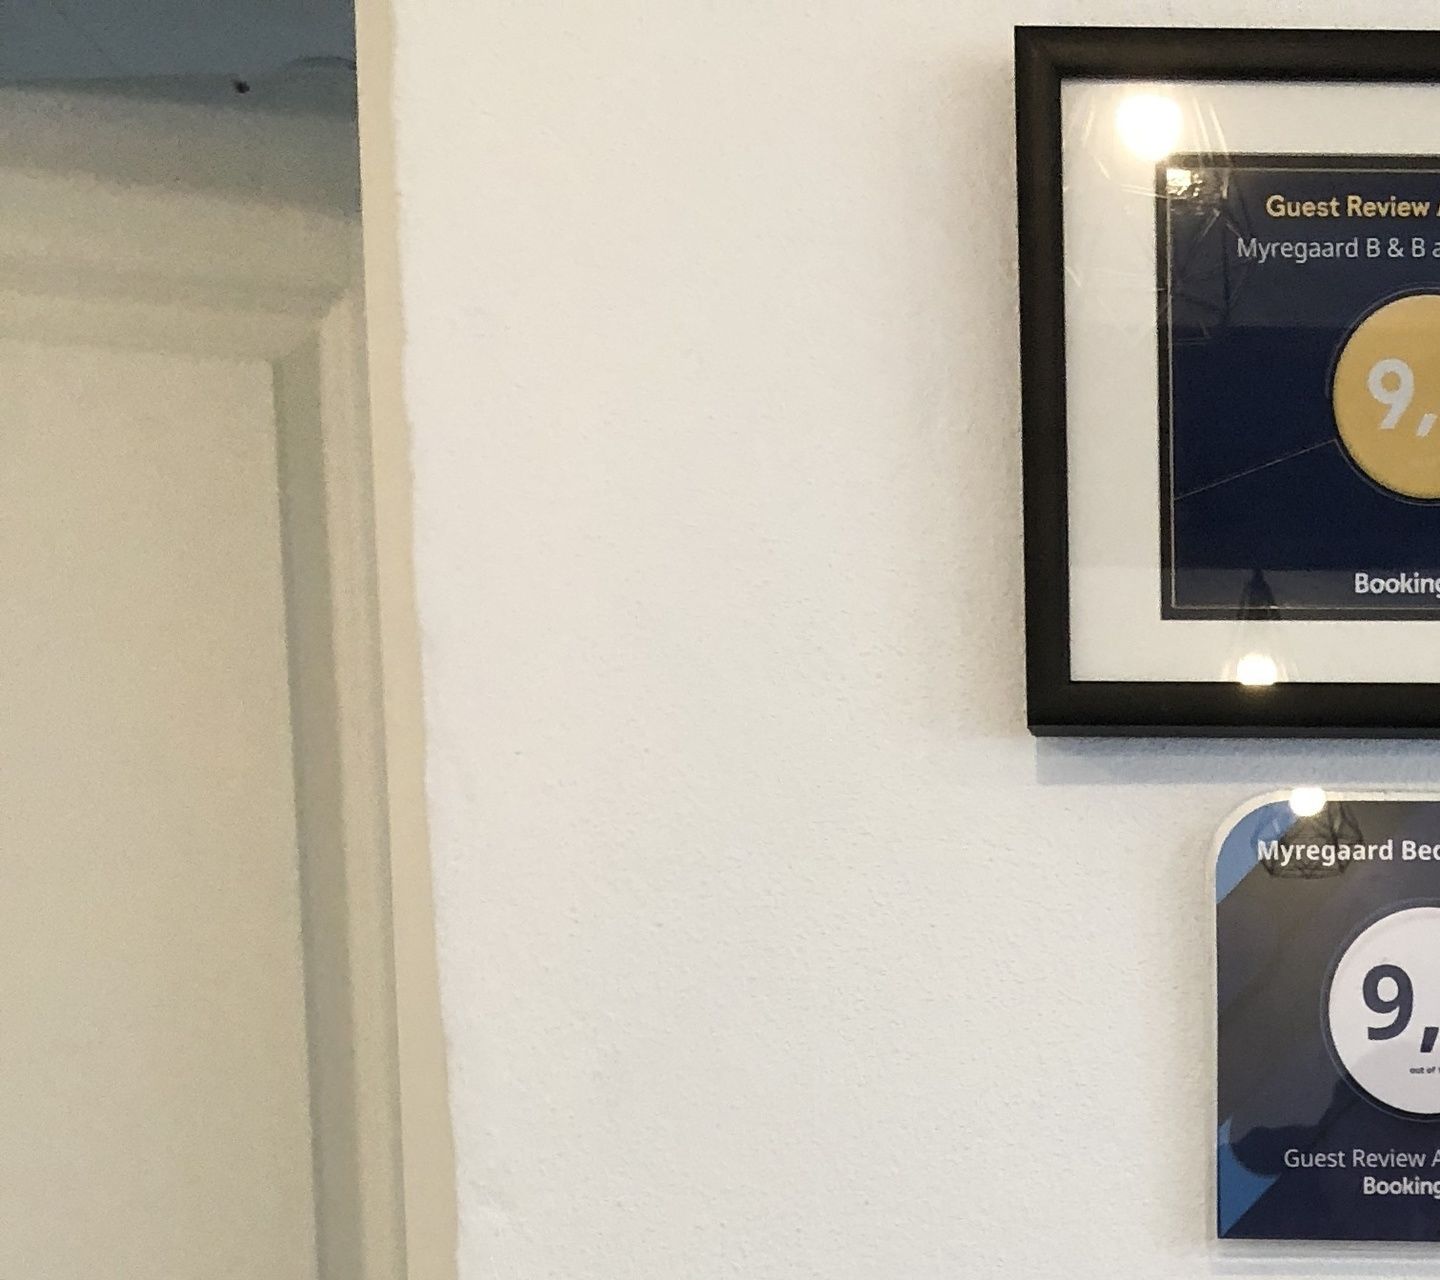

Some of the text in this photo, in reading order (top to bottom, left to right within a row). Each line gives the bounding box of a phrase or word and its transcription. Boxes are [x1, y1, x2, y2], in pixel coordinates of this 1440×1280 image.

[1266, 195, 1340, 217] Guest
[1347, 195, 1430, 217] Review
[1237, 237, 1358, 263] Myregaard
[1367, 239, 1380, 258] B
[1387, 238, 1404, 258] &
[1412, 239, 1425, 258] B
[1257, 840, 1393, 866] Myregaard
[1284, 1149, 1346, 1168] Guest
[1352, 1149, 1428, 1168] Review
